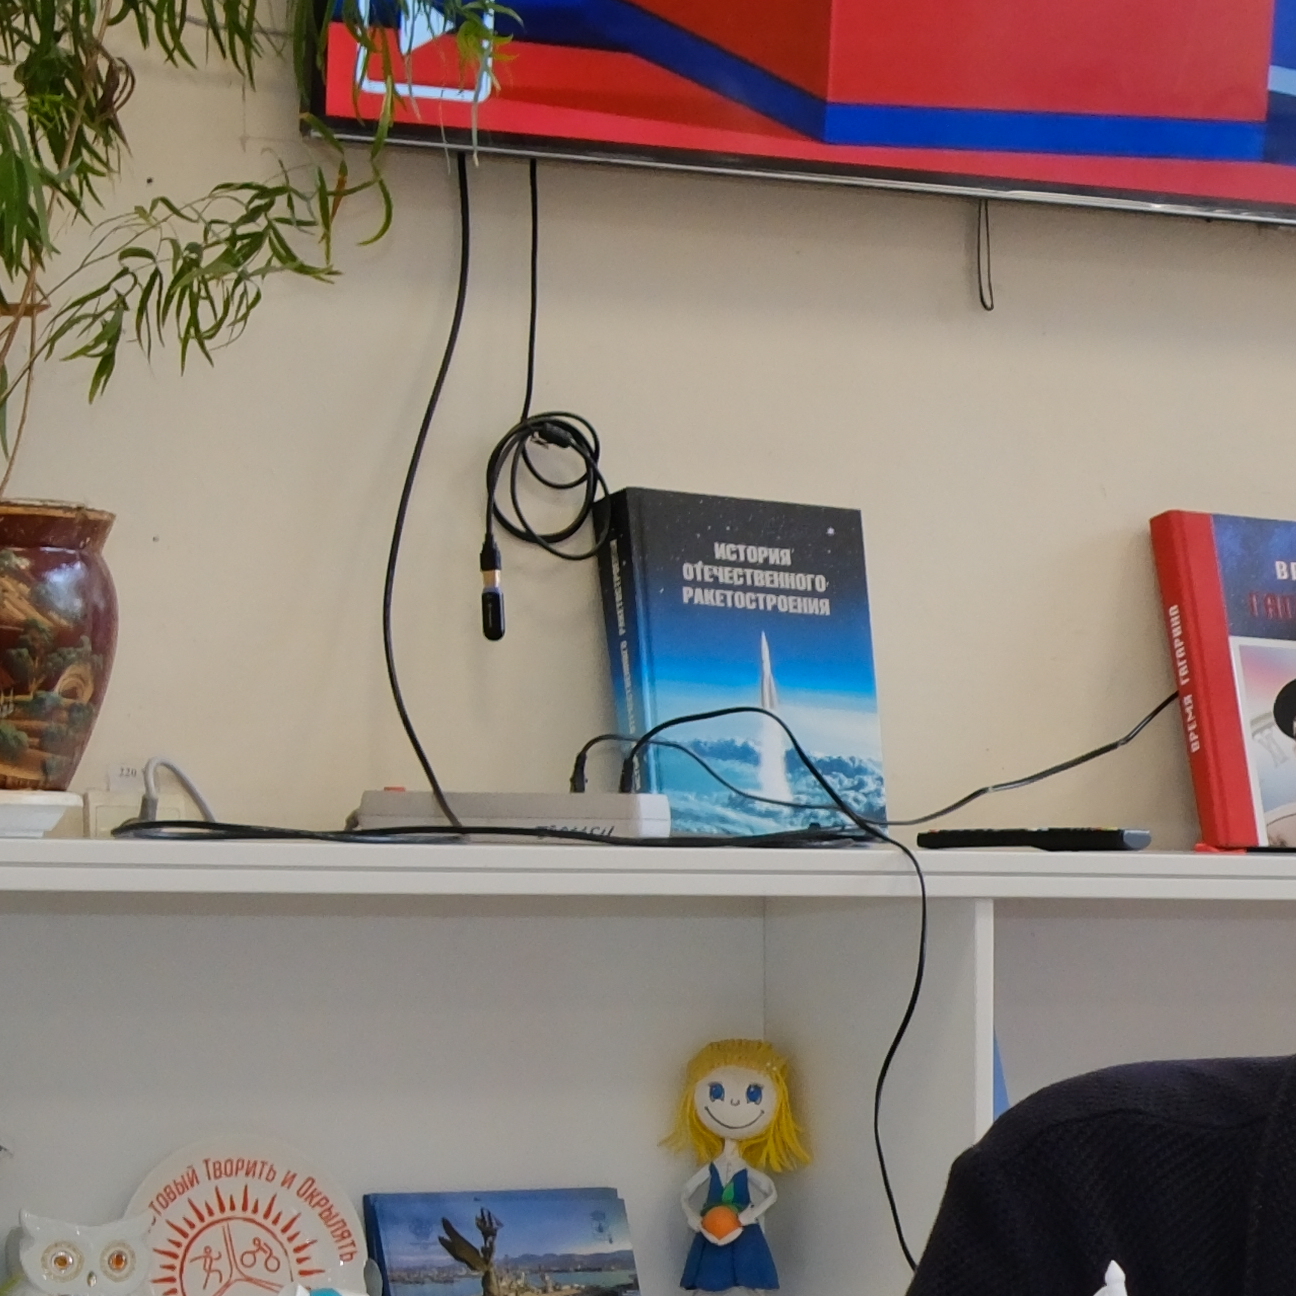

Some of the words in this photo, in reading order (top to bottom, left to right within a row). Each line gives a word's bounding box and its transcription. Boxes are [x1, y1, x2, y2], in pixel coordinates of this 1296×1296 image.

[714, 542, 792, 566] ИСТОРИЯ
[683, 562, 827, 593] ОТЕЧЕСТВЕННОГО
[683, 586, 830, 616] РАКЕТОСТРОЕНИЯ
[1169, 604, 1191, 686] ГАГАРИНА
[1182, 693, 1201, 753] ВРЕМЯ
